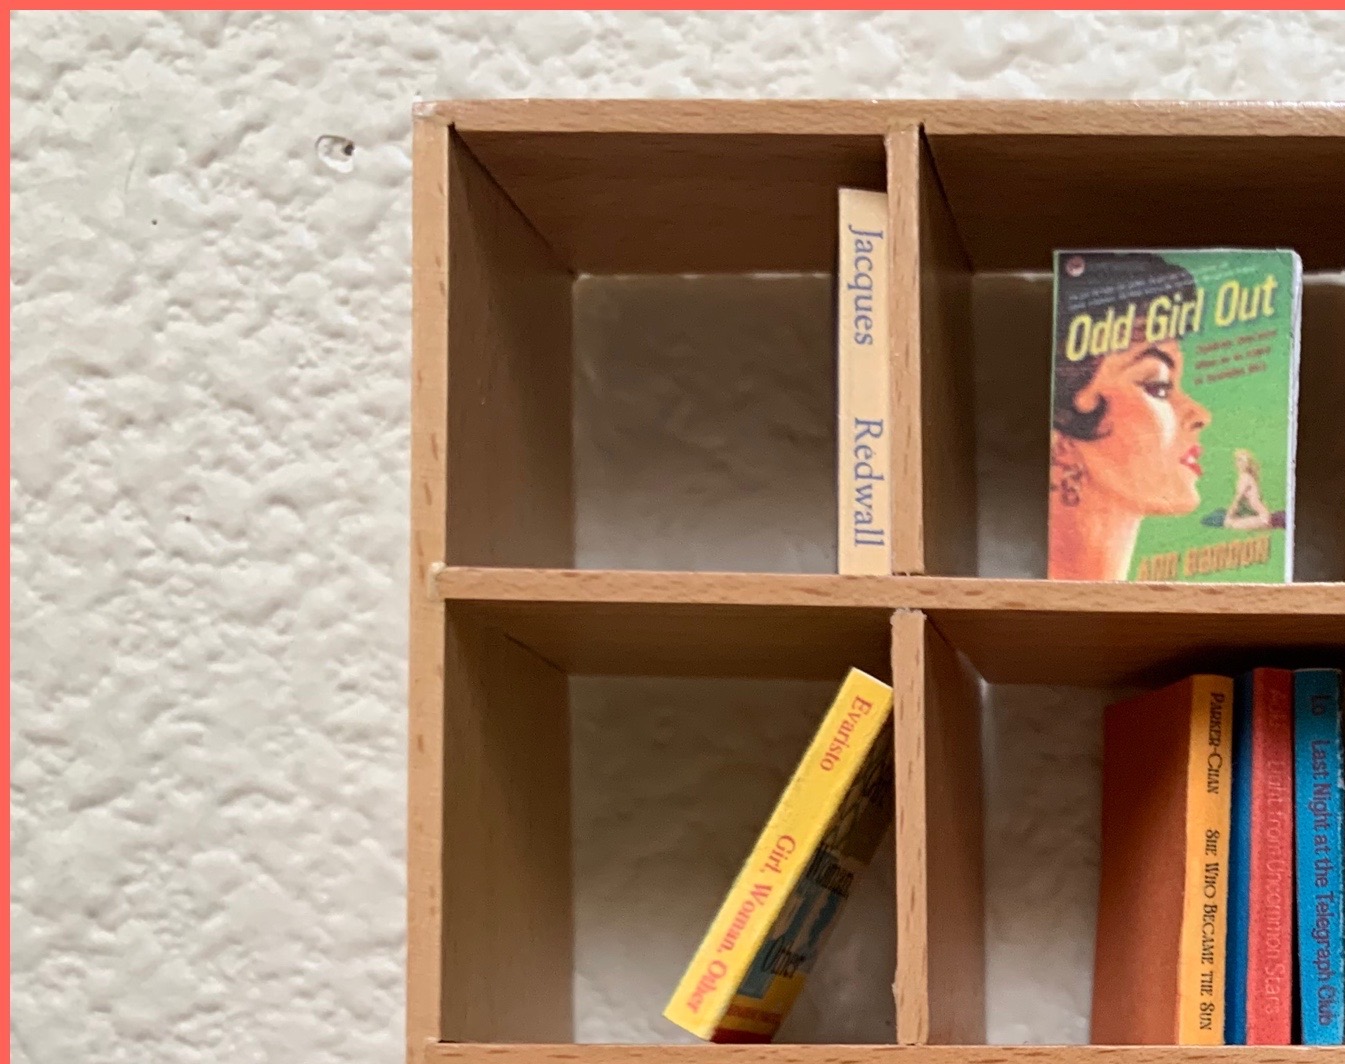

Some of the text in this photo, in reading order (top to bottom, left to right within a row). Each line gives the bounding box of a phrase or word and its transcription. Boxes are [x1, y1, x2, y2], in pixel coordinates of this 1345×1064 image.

[1065, 304, 1135, 361] Odd
[1146, 287, 1205, 341] Girl
[1214, 275, 1278, 327] Out
[848, 224, 885, 547] Jacques Redwall
[820, 696, 872, 772] Evaristo
[1311, 739, 1331, 781] Last
[1307, 783, 1332, 832] Night
[759, 834, 796, 873] Girl,
[1205, 829, 1220, 856] SHE
[1314, 834, 1330, 854] at
[1203, 862, 1220, 899] WHO
[1314, 857, 1335, 888] the
[716, 884, 773, 953] Woman,
[1200, 903, 1218, 965] BECAME
[1311, 891, 1336, 982] Telegraph
[687, 960, 728, 1014] Other
[1264, 963, 1286, 1015] Stars
[1318, 985, 1337, 1026] Club
[1199, 1002, 1215, 1031] SUN
